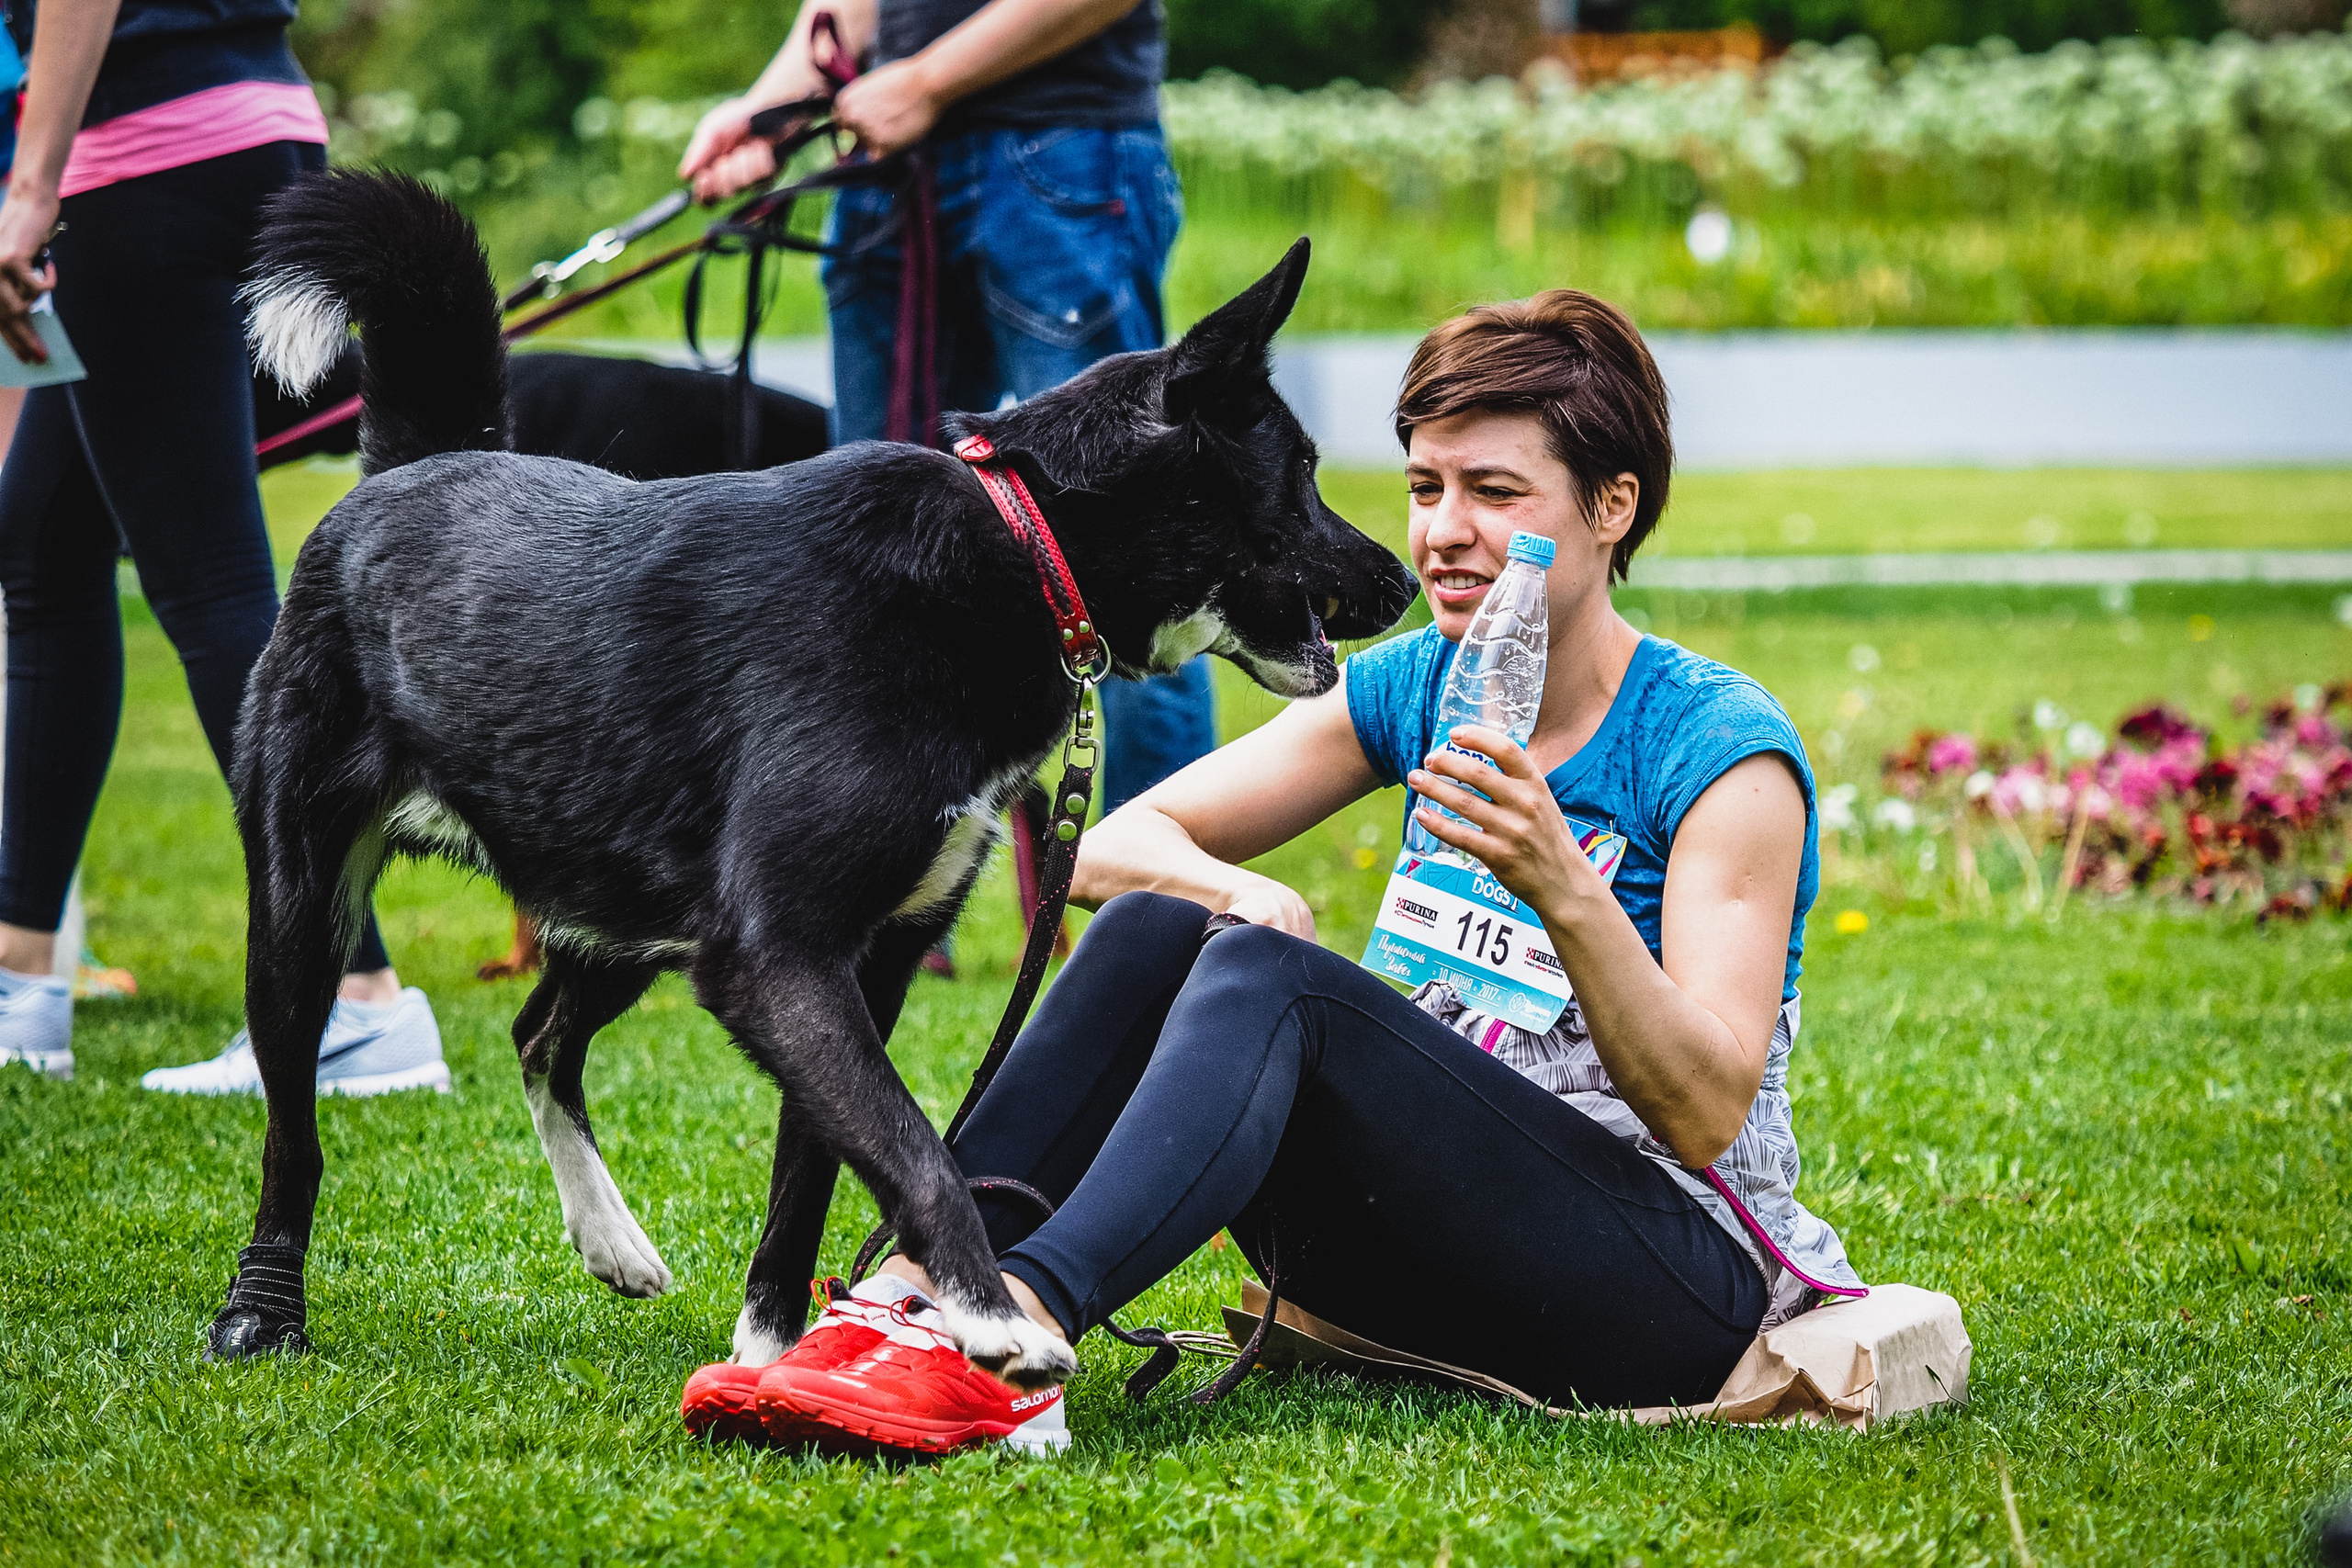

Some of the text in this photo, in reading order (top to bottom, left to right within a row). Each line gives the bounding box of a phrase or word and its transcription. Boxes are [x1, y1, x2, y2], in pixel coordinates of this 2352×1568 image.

[1405, 900, 1436, 920] PURINA
[1457, 910, 1513, 965] 115
[1438, 967, 1499, 1001] 10 ИЮНЯ 2017
